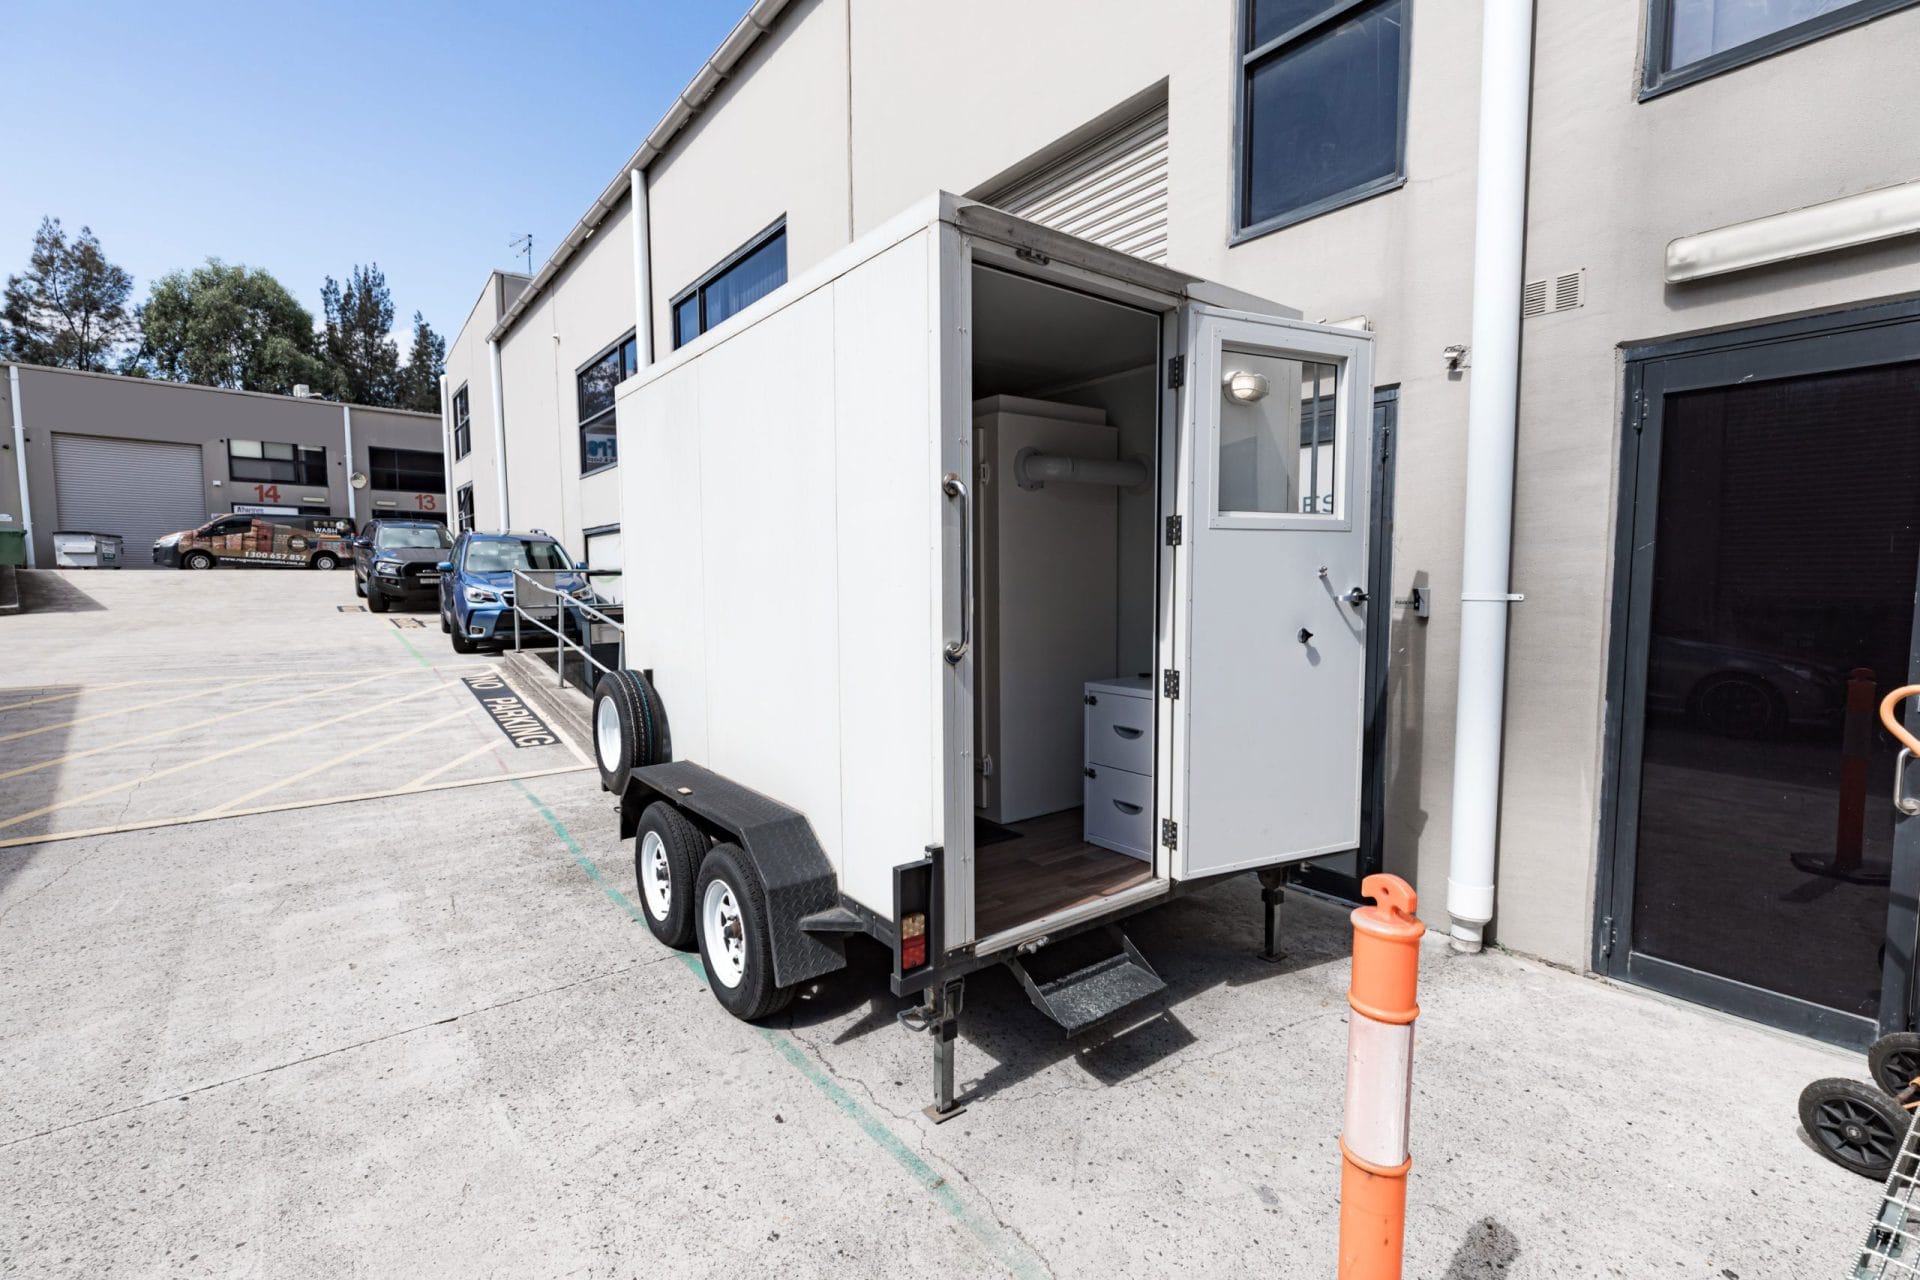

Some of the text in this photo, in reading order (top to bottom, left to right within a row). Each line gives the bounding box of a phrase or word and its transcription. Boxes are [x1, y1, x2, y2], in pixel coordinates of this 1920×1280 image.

[254, 484, 281, 503] 14
[414, 494, 436, 511] 13
[270, 552, 288, 560] 657
[466, 671, 555, 747] NO PARKING
